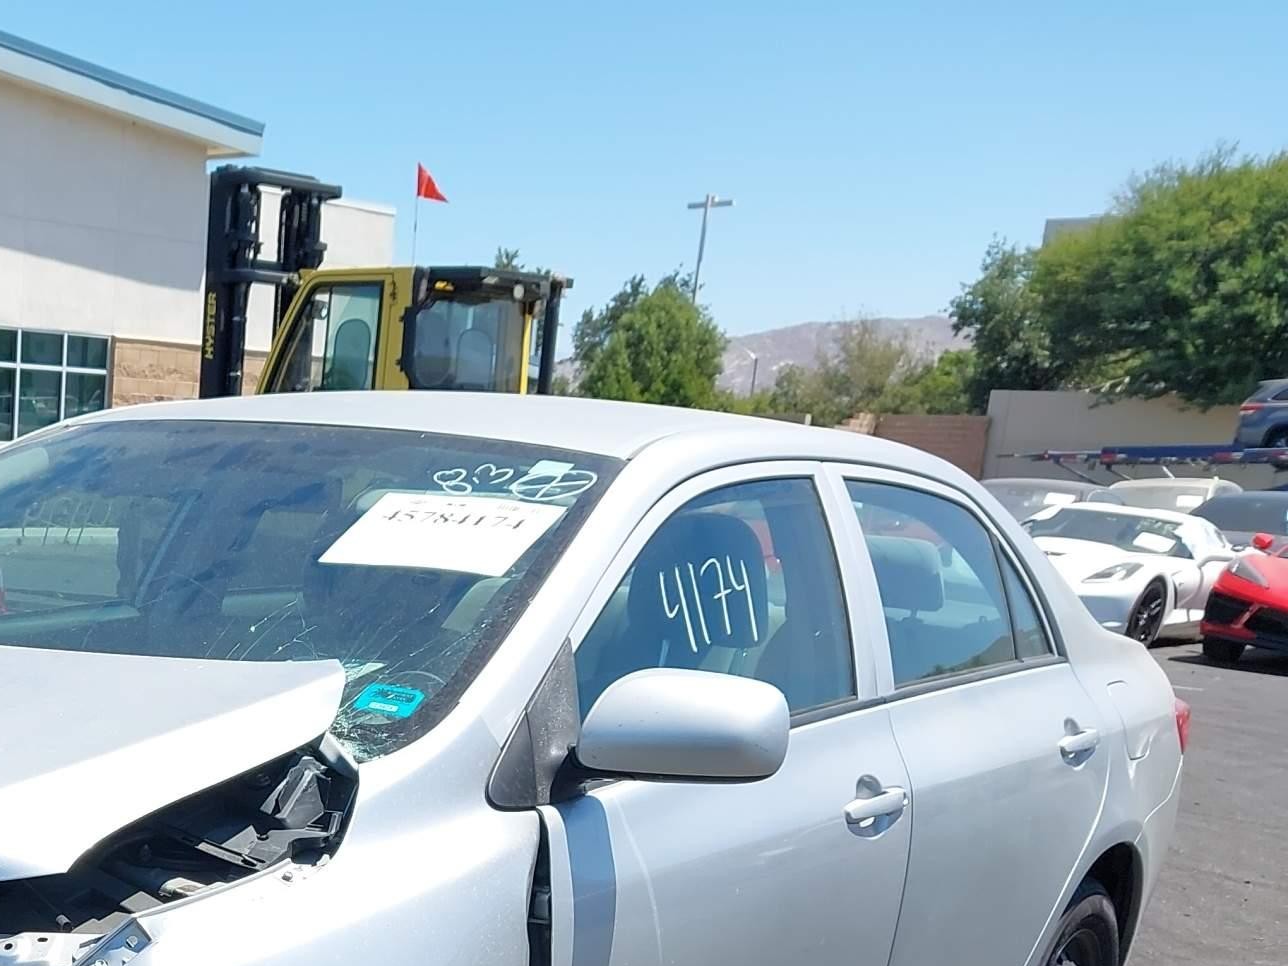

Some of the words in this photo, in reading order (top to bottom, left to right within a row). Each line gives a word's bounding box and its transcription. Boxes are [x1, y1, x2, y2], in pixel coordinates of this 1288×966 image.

[205, 291, 217, 360] HYSTER
[383, 510, 525, 530] 45784174
[658, 555, 759, 653] 4174
